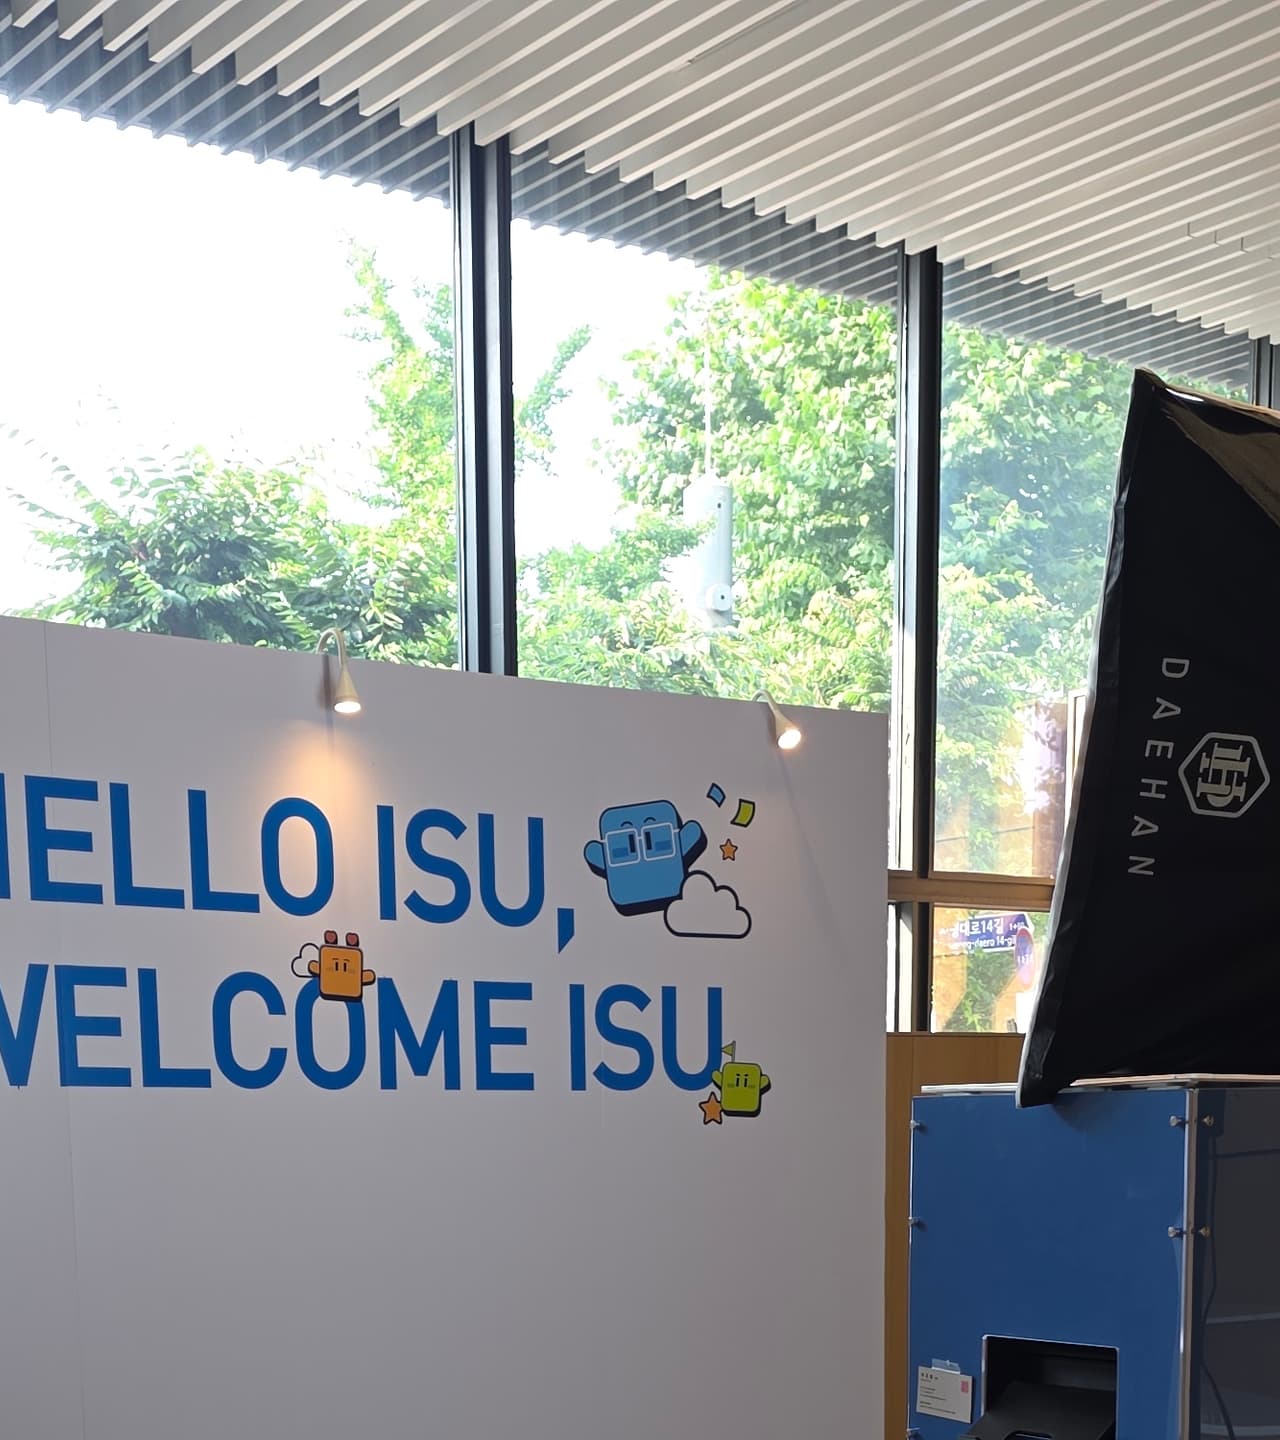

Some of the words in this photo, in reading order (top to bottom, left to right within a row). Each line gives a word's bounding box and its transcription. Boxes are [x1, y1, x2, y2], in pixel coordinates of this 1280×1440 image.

[1128, 657, 1190, 877] DAEHAN
[376, 804, 576, 955] ISU,
[569, 983, 723, 1092] ISU
